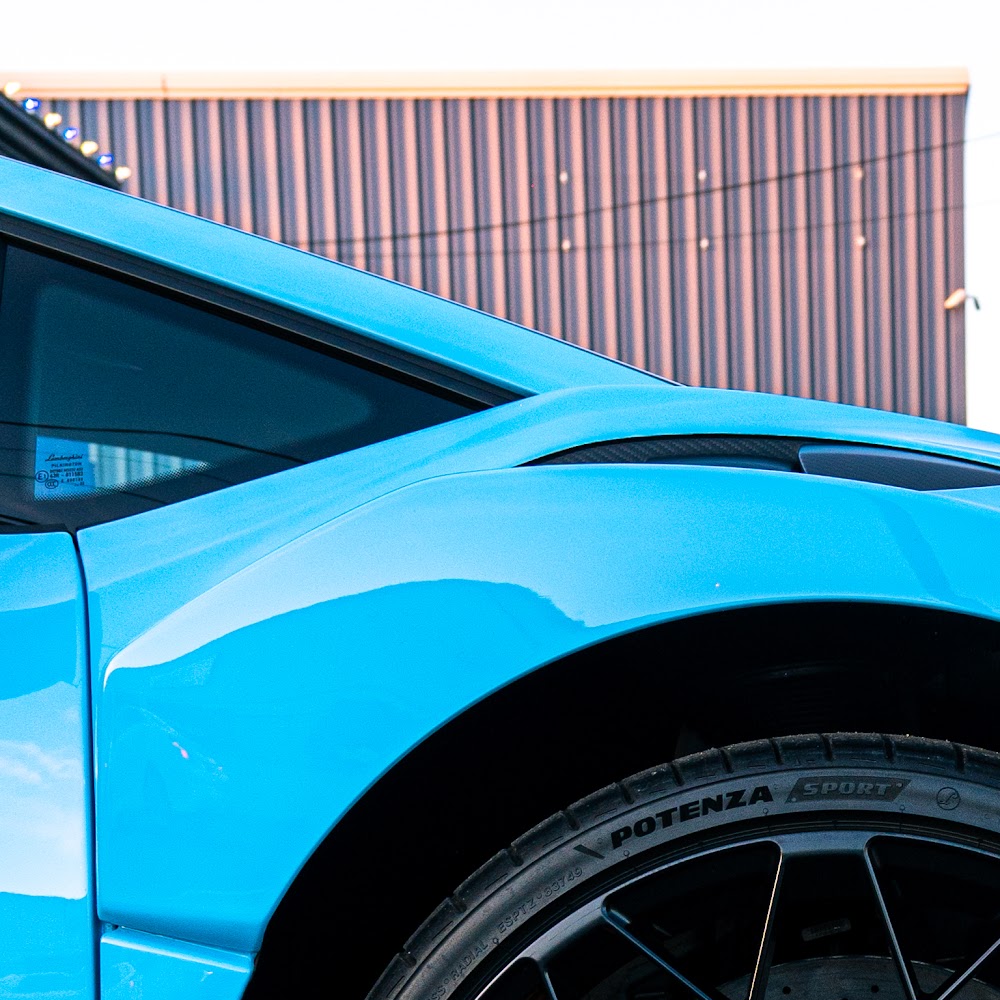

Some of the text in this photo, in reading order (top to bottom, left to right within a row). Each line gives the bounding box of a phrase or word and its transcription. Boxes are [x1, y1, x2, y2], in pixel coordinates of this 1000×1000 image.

[611, 778, 891, 850] POTENZA SPORT
[451, 939, 489, 983] RADIAL
